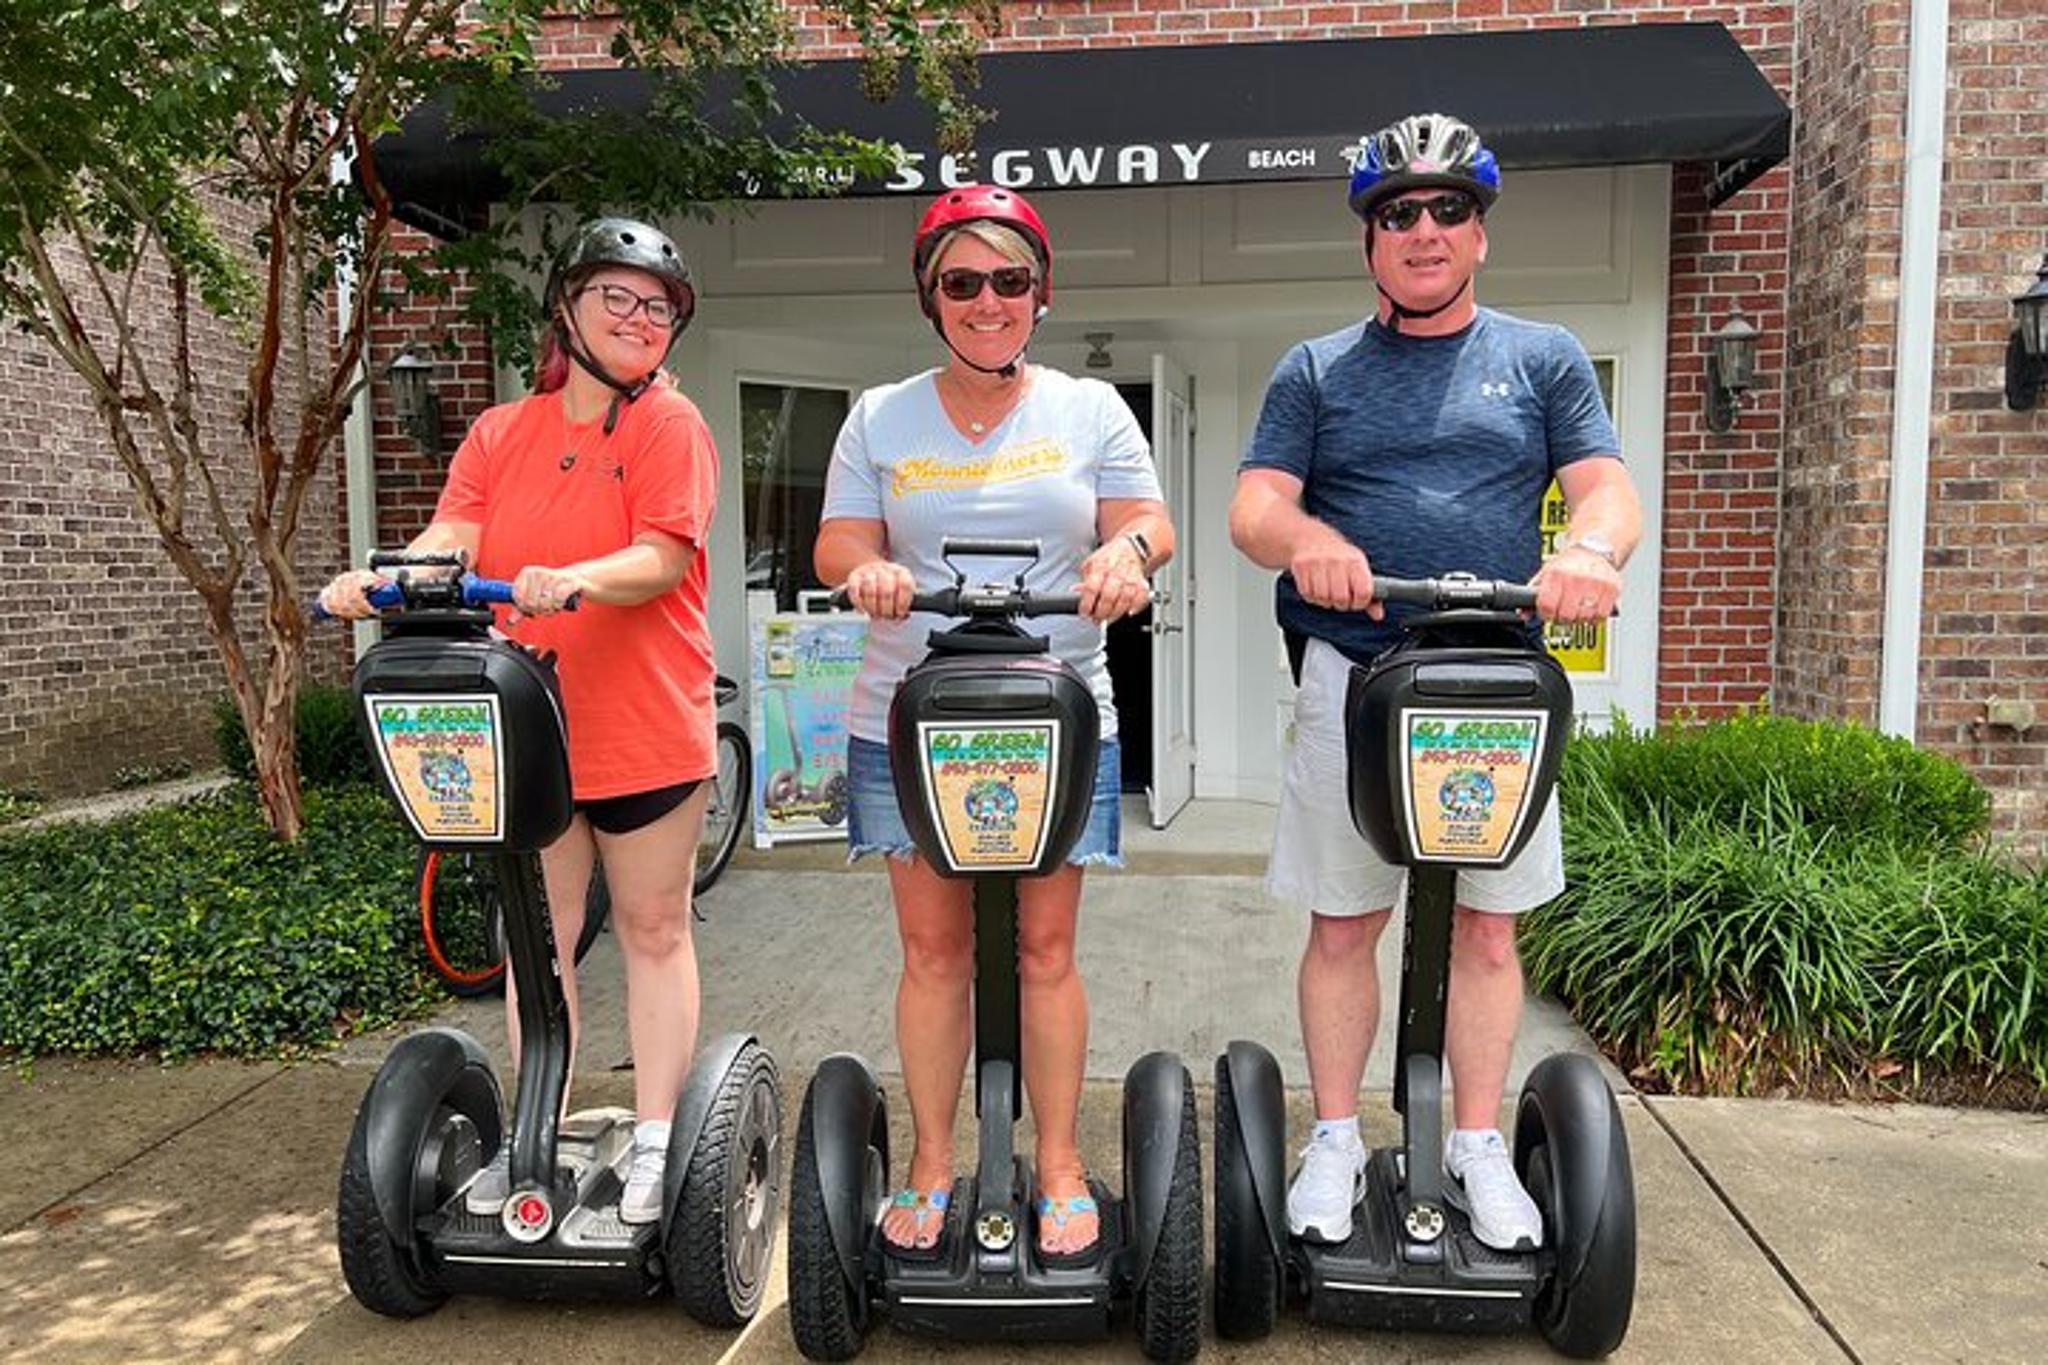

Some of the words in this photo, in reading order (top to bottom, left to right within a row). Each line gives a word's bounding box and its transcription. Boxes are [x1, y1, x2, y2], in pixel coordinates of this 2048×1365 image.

[885, 142, 1212, 191] SEGWAY
[1248, 149, 1315, 168] BEACH
[1416, 721, 1446, 737] GO
[1454, 721, 1534, 738] GREEN
[933, 733, 962, 749] GO
[971, 732, 1046, 749] GREEN
